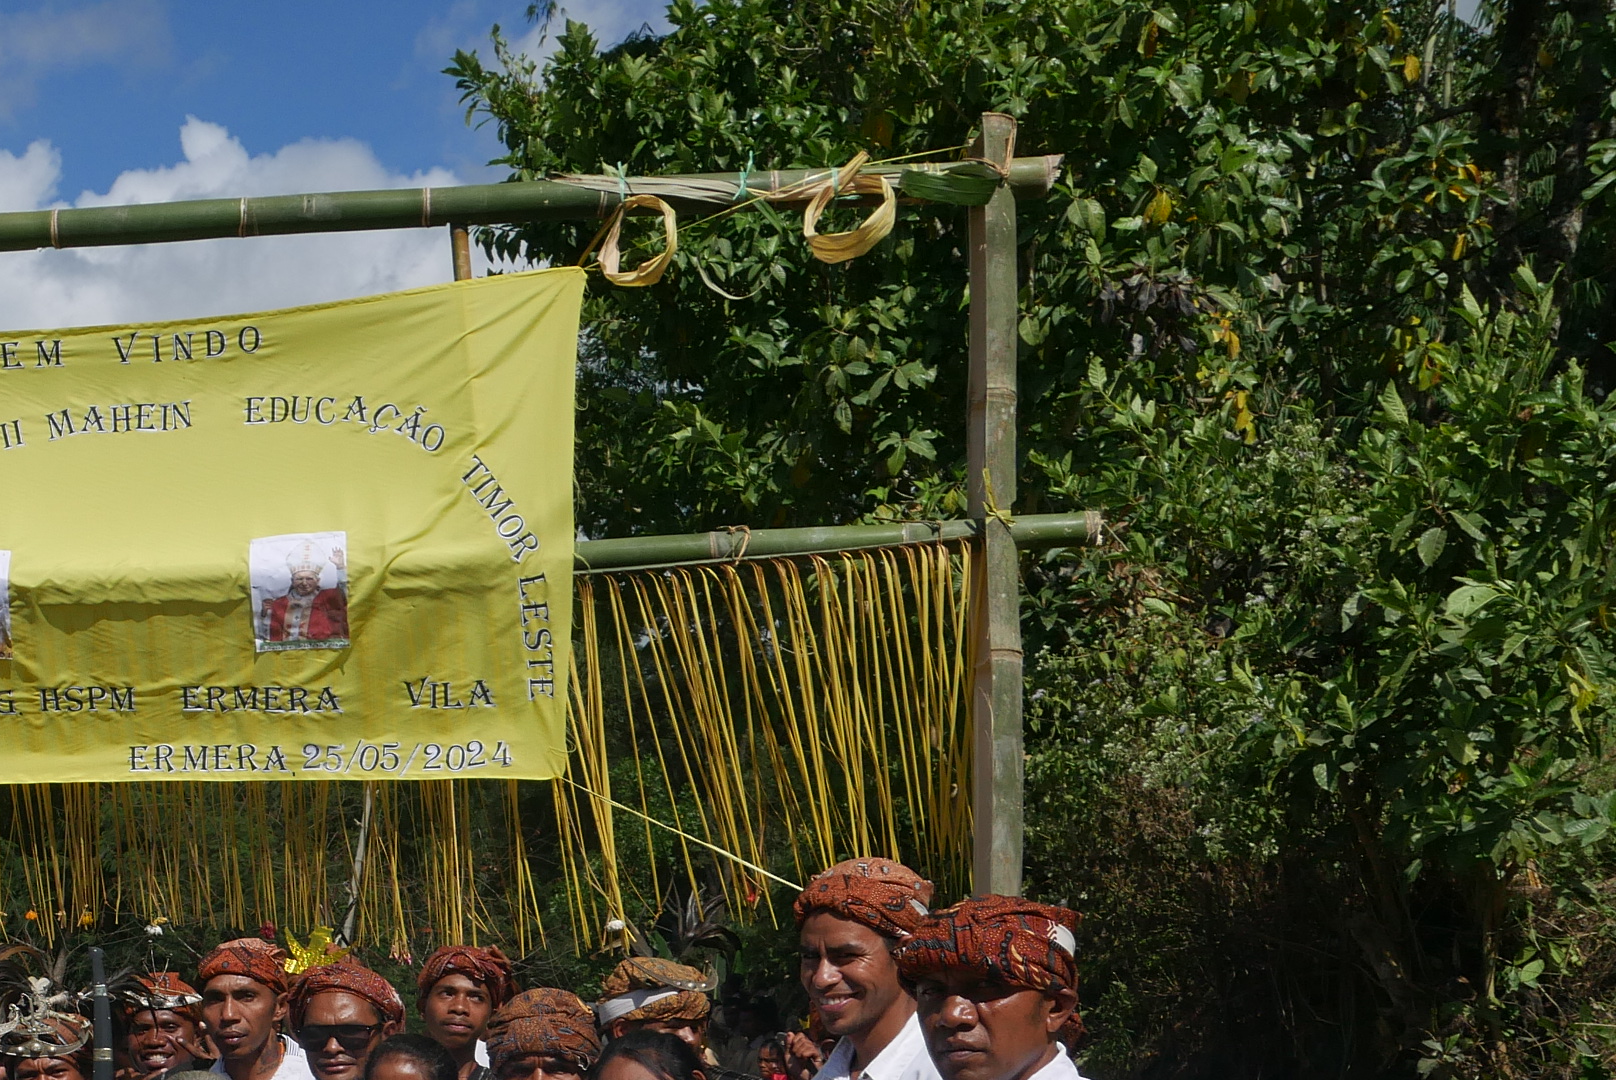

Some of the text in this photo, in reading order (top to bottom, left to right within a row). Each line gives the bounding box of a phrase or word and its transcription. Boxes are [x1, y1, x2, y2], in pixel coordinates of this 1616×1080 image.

[112, 326, 263, 364] VINDO
[0, 420, 25, 449] II
[46, 400, 192, 441] MAHEIN
[244, 395, 446, 452] EDUCAÇÃO
[462, 455, 540, 563] TIMOR
[518, 572, 556, 701] LESTE
[39, 686, 137, 713] HSPM
[181, 685, 344, 714] ERMERA
[404, 676, 497, 709] VILA
[302, 739, 513, 776] 25/05/2024
